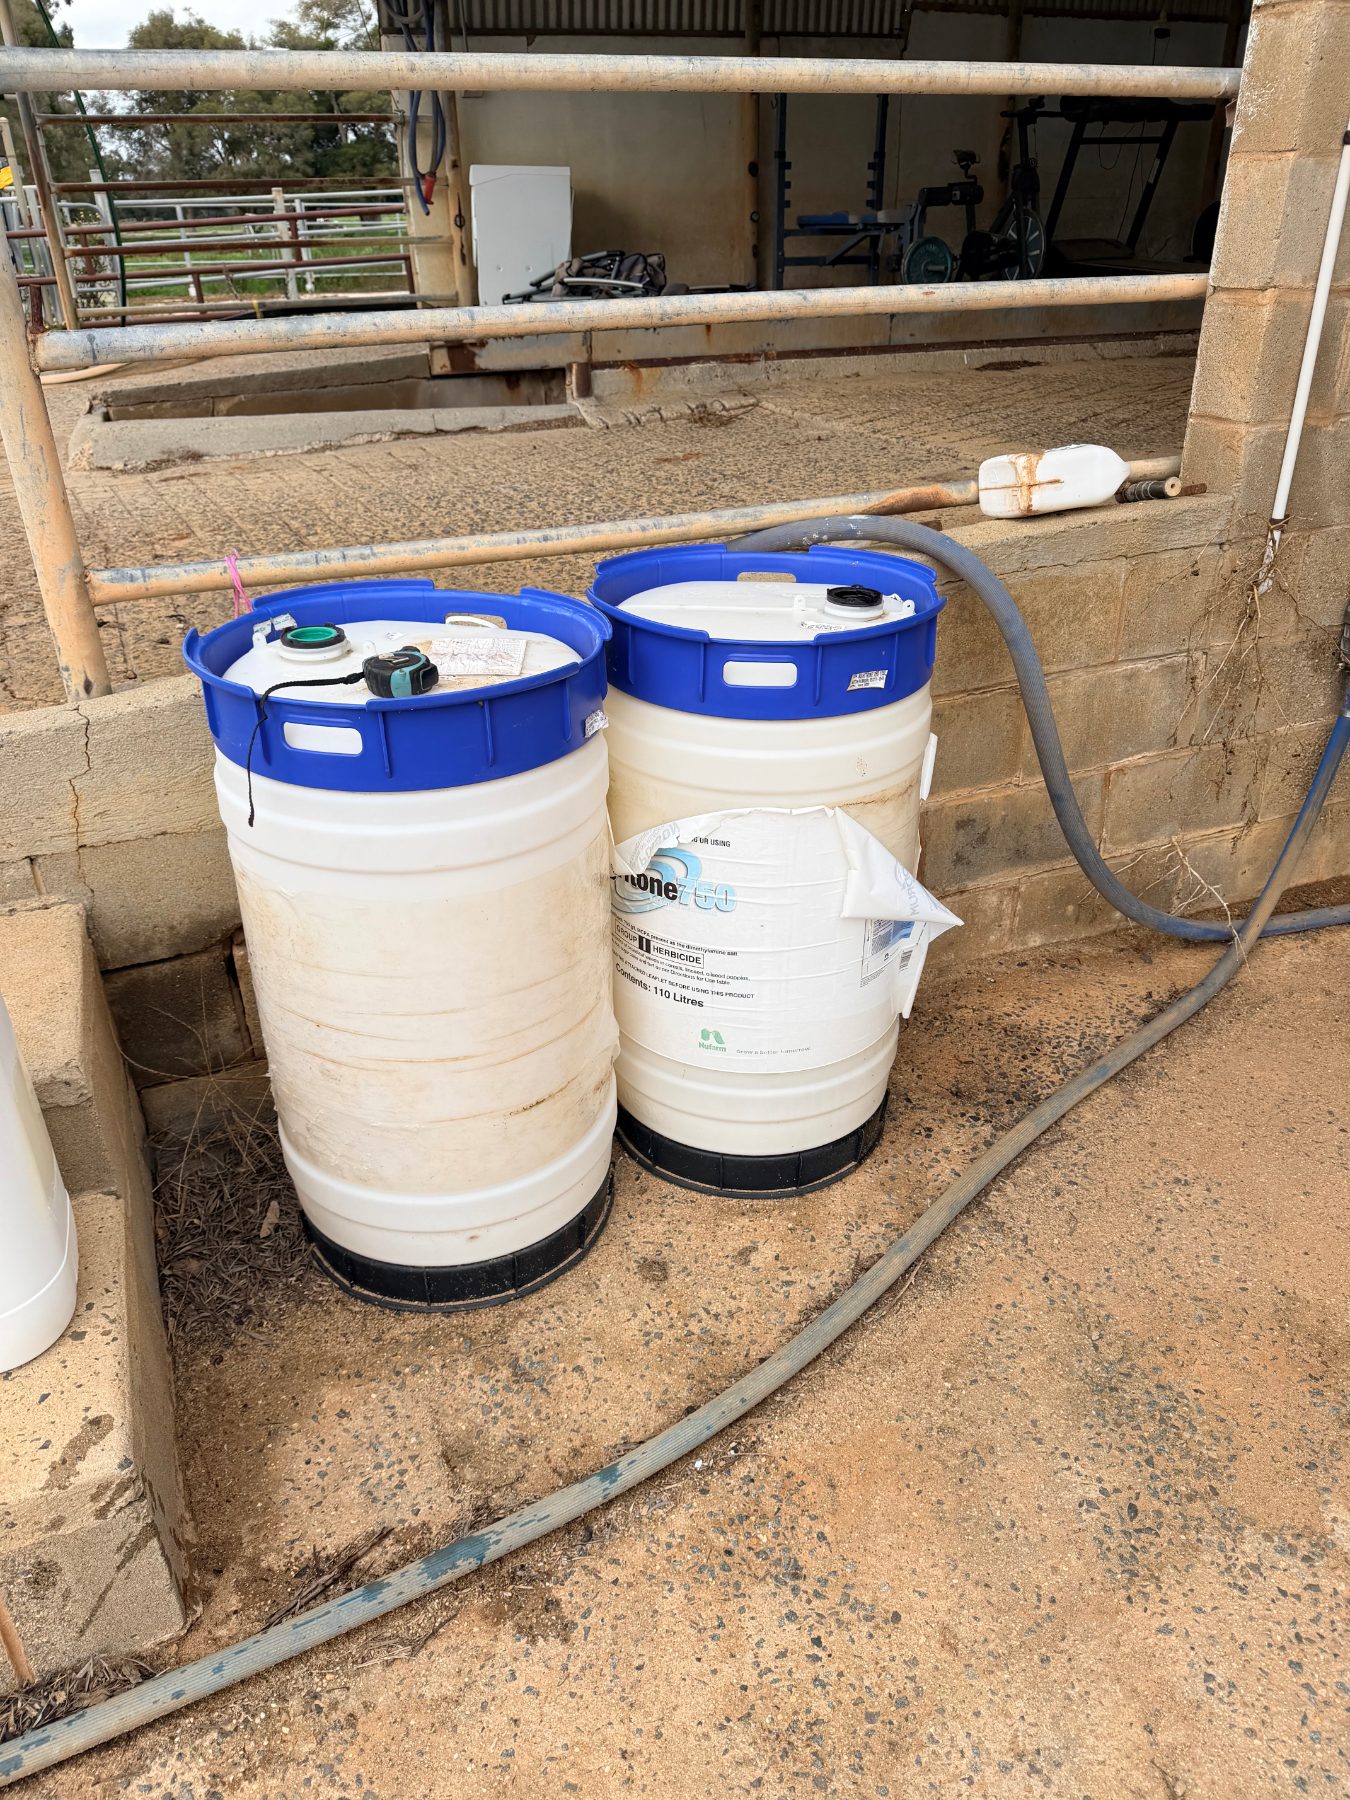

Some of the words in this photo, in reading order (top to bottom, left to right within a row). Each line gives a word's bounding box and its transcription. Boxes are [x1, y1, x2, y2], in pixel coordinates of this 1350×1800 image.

[710, 838, 731, 848] USING
[616, 924, 637, 943] GROUP
[653, 945, 702, 965] HERBICIDE
[651, 935, 668, 944] present
[686, 944, 726, 956] dimethylamine
[615, 962, 651, 992] Contents:
[653, 986, 671, 999] 110
[673, 992, 704, 1008] Litres
[646, 972, 668, 985] LEAFLET
[668, 980, 690, 991] BEFORE
[691, 986, 710, 995] USING
[698, 1041, 727, 1053] Nufarm
